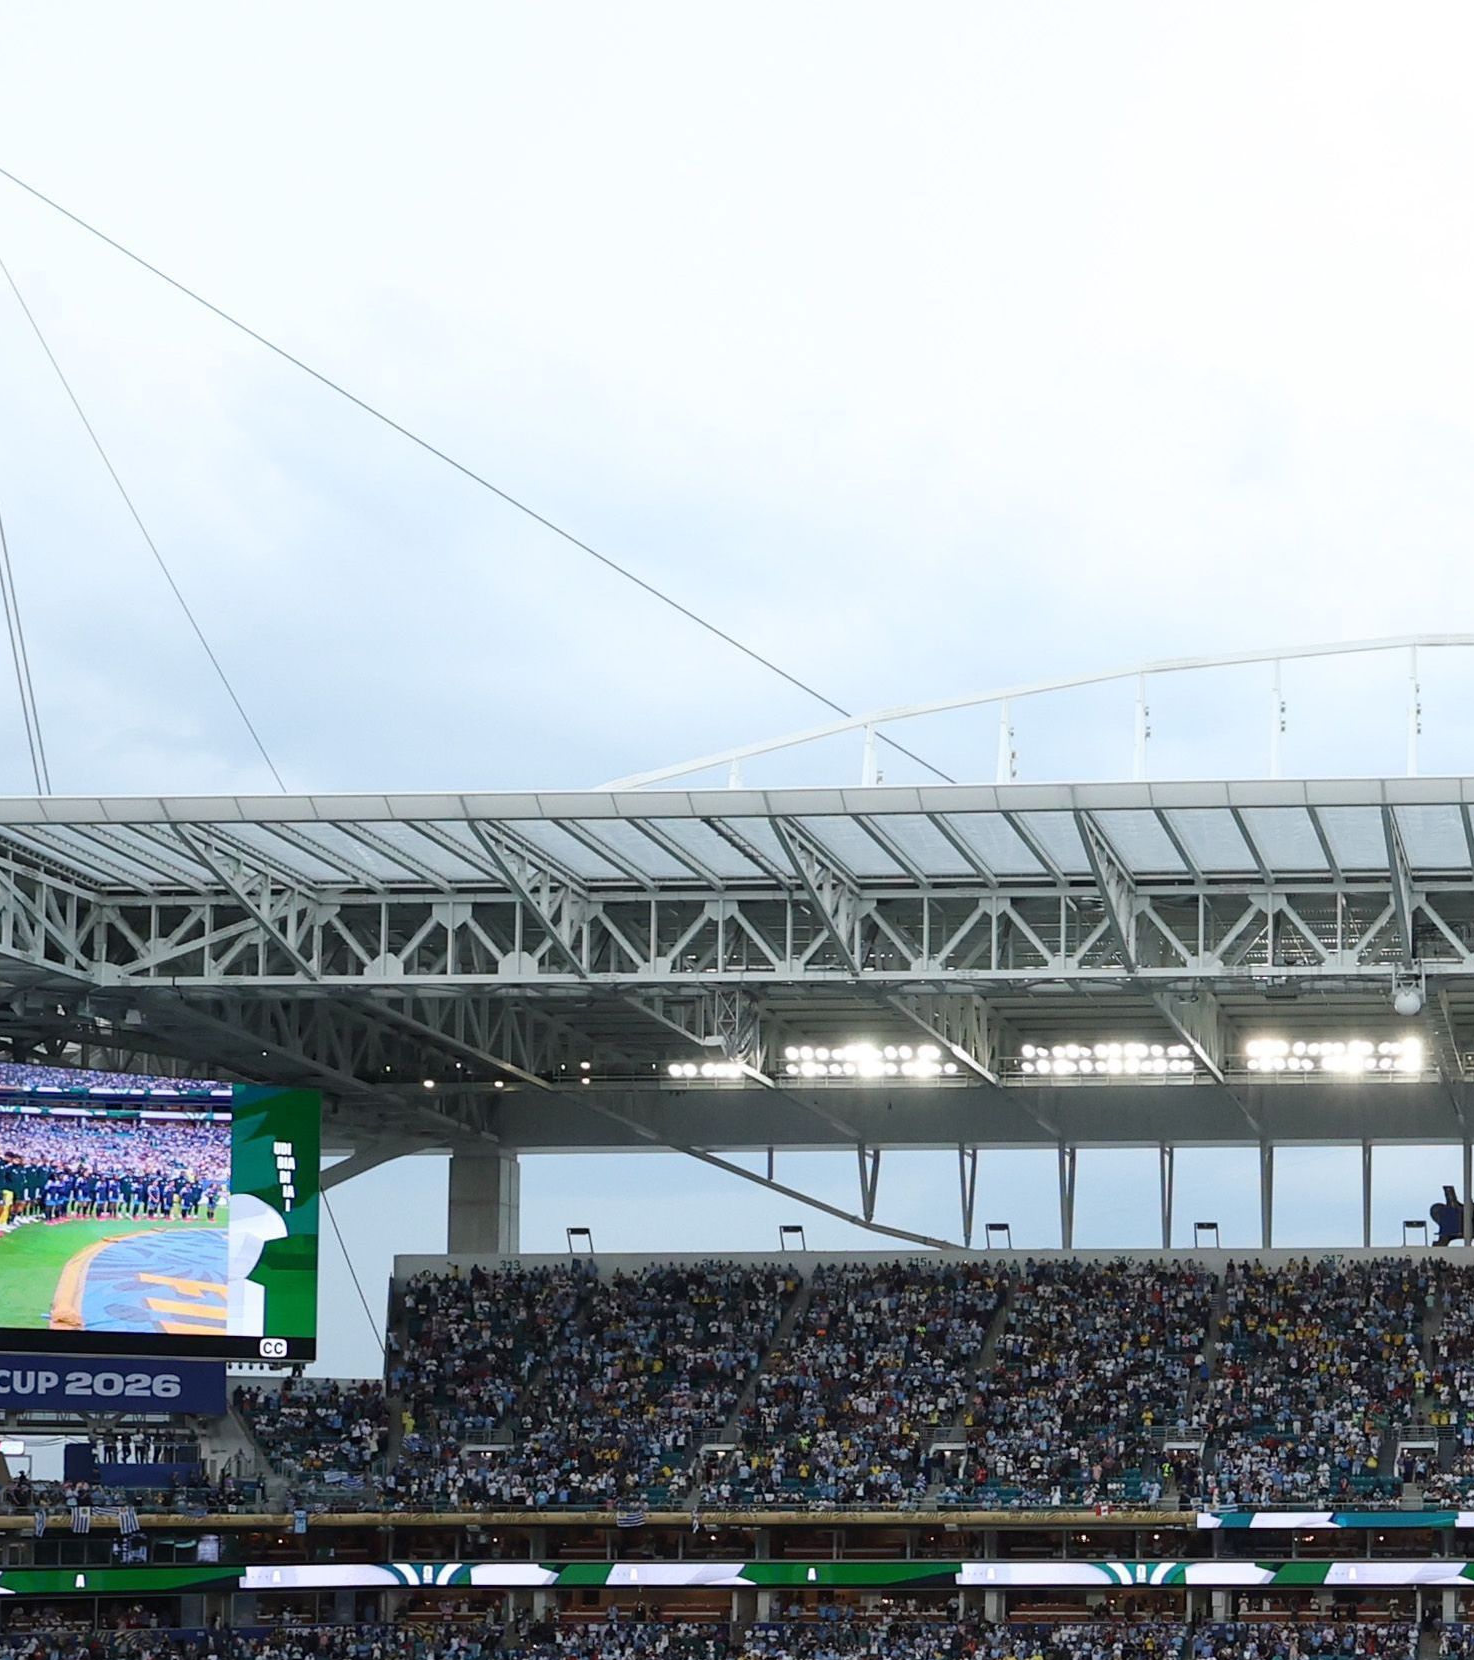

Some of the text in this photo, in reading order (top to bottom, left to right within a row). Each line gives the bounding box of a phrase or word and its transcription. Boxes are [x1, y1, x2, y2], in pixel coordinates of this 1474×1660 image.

[500, 1259, 521, 1270] 313
[1322, 1254, 1344, 1265] 317
[262, 1340, 284, 1355] CC
[63, 1371, 181, 1398] 2026
